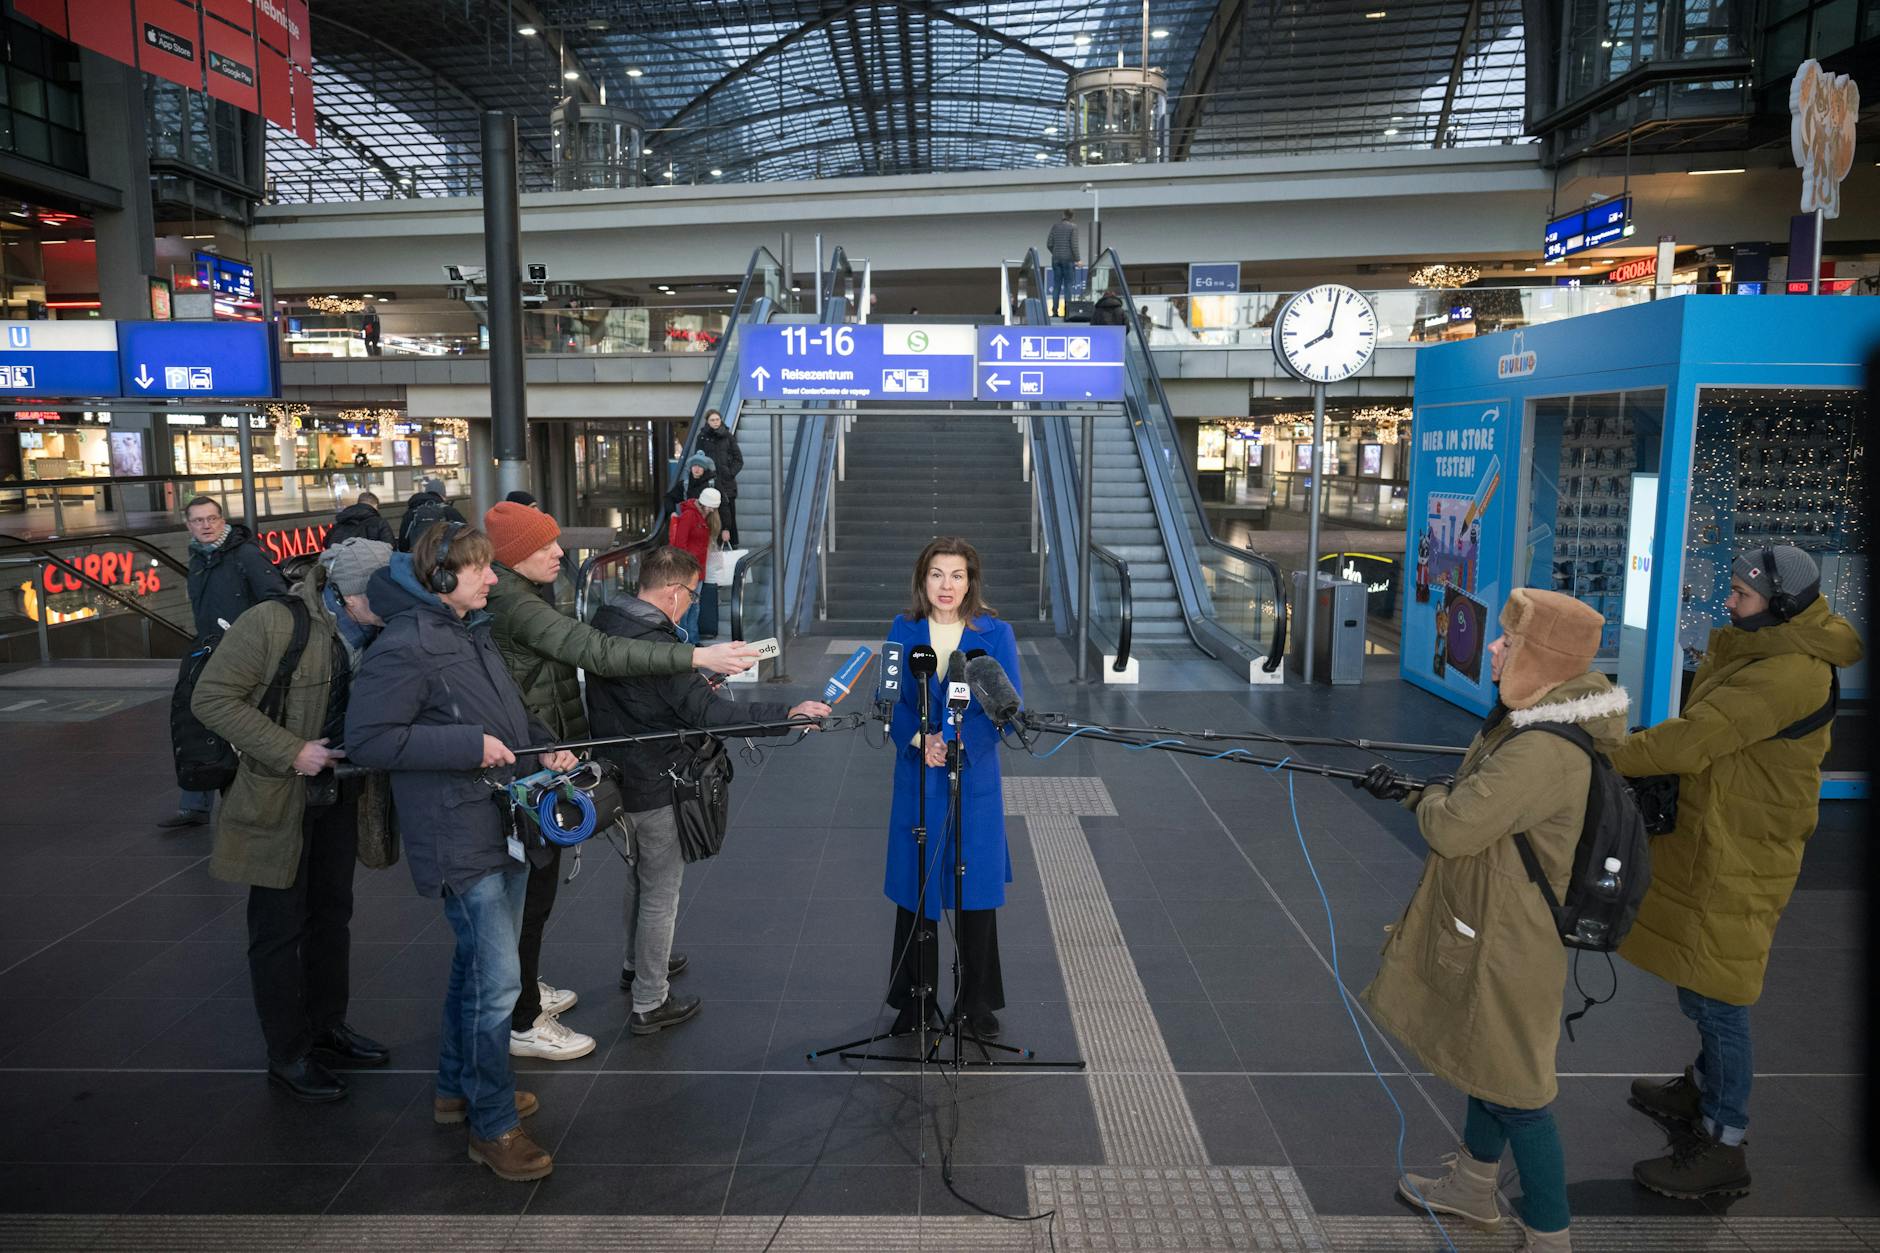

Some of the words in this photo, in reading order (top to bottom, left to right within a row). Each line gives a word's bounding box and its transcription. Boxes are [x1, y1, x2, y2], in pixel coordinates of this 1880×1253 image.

[158, 38, 173, 50] App
[173, 42, 191, 57] Store
[222, 64, 241, 79] Google
[1195, 277, 1213, 287] E-G
[1609, 272, 1617, 280] LE
[1459, 307, 1472, 319] 12
[781, 326, 854, 356] 11-16
[781, 368, 854, 381] Reisezentrum
[1023, 382, 1039, 391] WC
[1423, 430, 1443, 452] HIER
[1446, 429, 1459, 450] IM
[1461, 428, 1495, 450] STORE
[1435, 456, 1475, 478] TESTEN!
[43, 551, 134, 593] CURRY
[134, 570, 161, 596] 36
